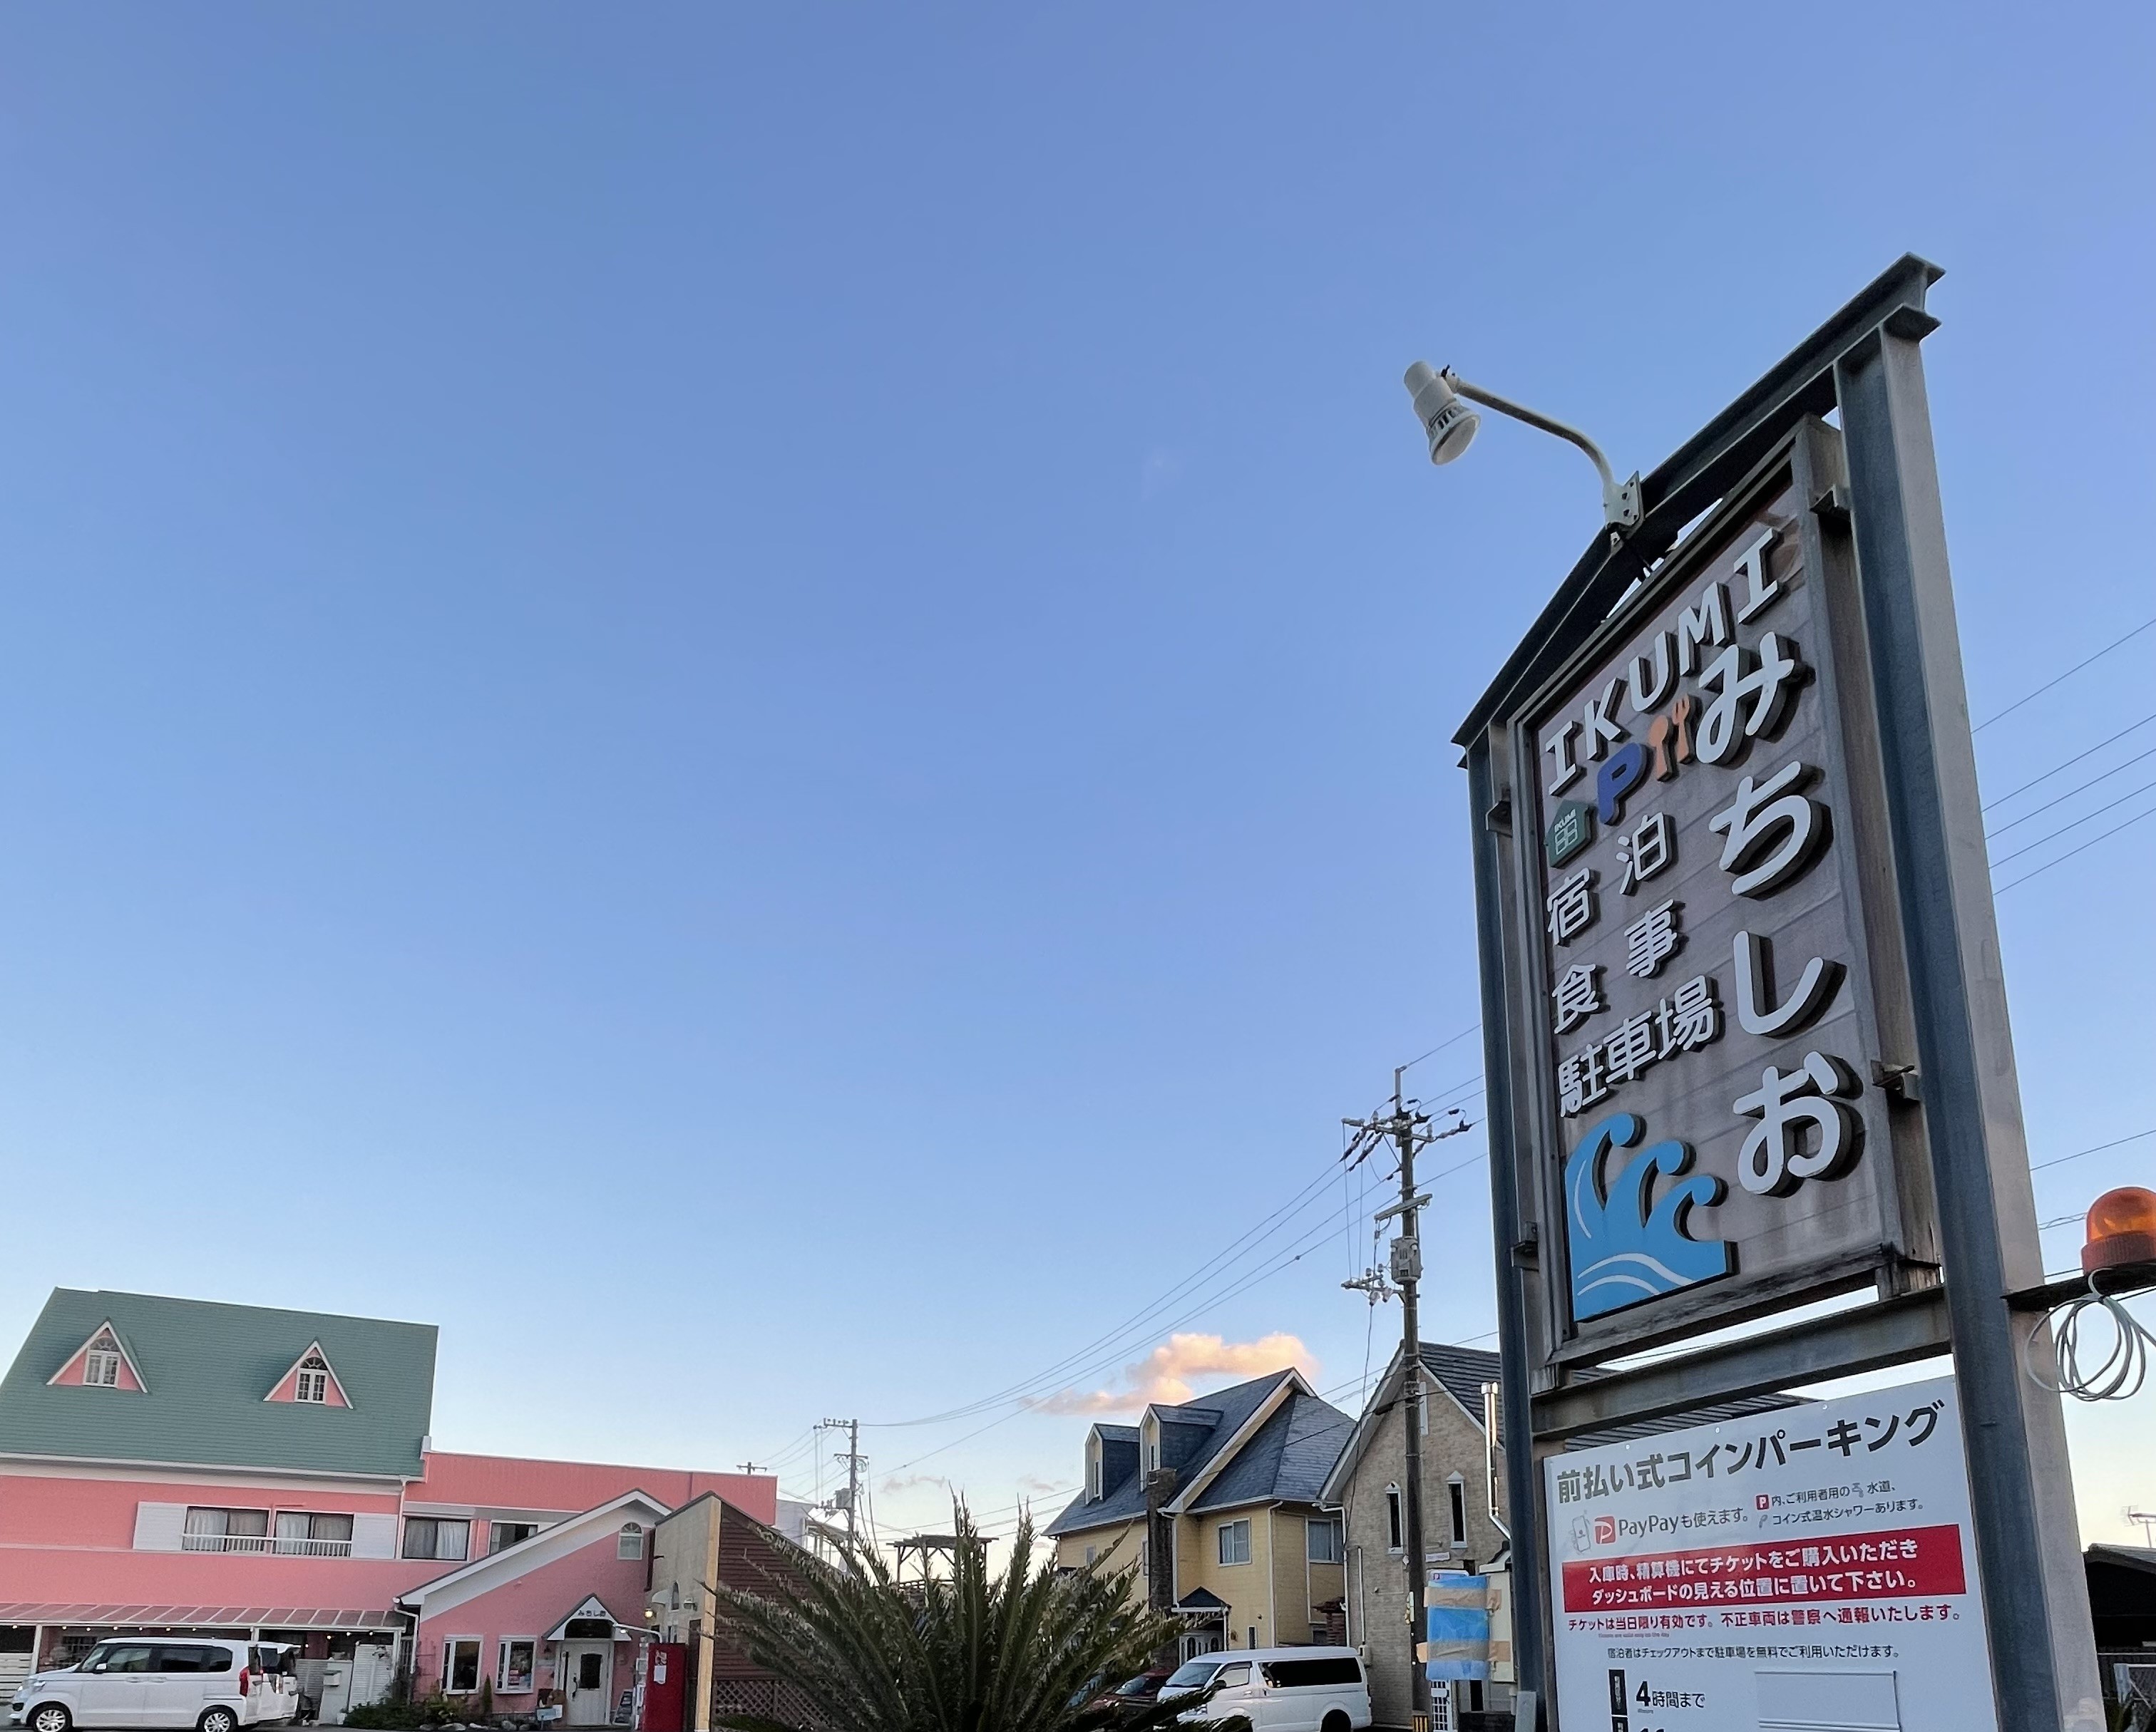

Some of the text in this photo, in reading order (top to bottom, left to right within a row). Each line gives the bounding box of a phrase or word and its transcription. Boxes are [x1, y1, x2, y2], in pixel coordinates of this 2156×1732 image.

[1545, 528, 1780, 796] IKUMI
[1597, 743, 1648, 825] P
[1695, 631, 1842, 1195] みちしお
[1557, 975, 1713, 1118] 駐車場
[1557, 1399, 1946, 1504] 前払い式コインパーキング
[1592, 1570, 1916, 1605] ダッシュボードの見える位置に置いて下さい。
[1636, 1681, 1705, 1708] 4時間まで
